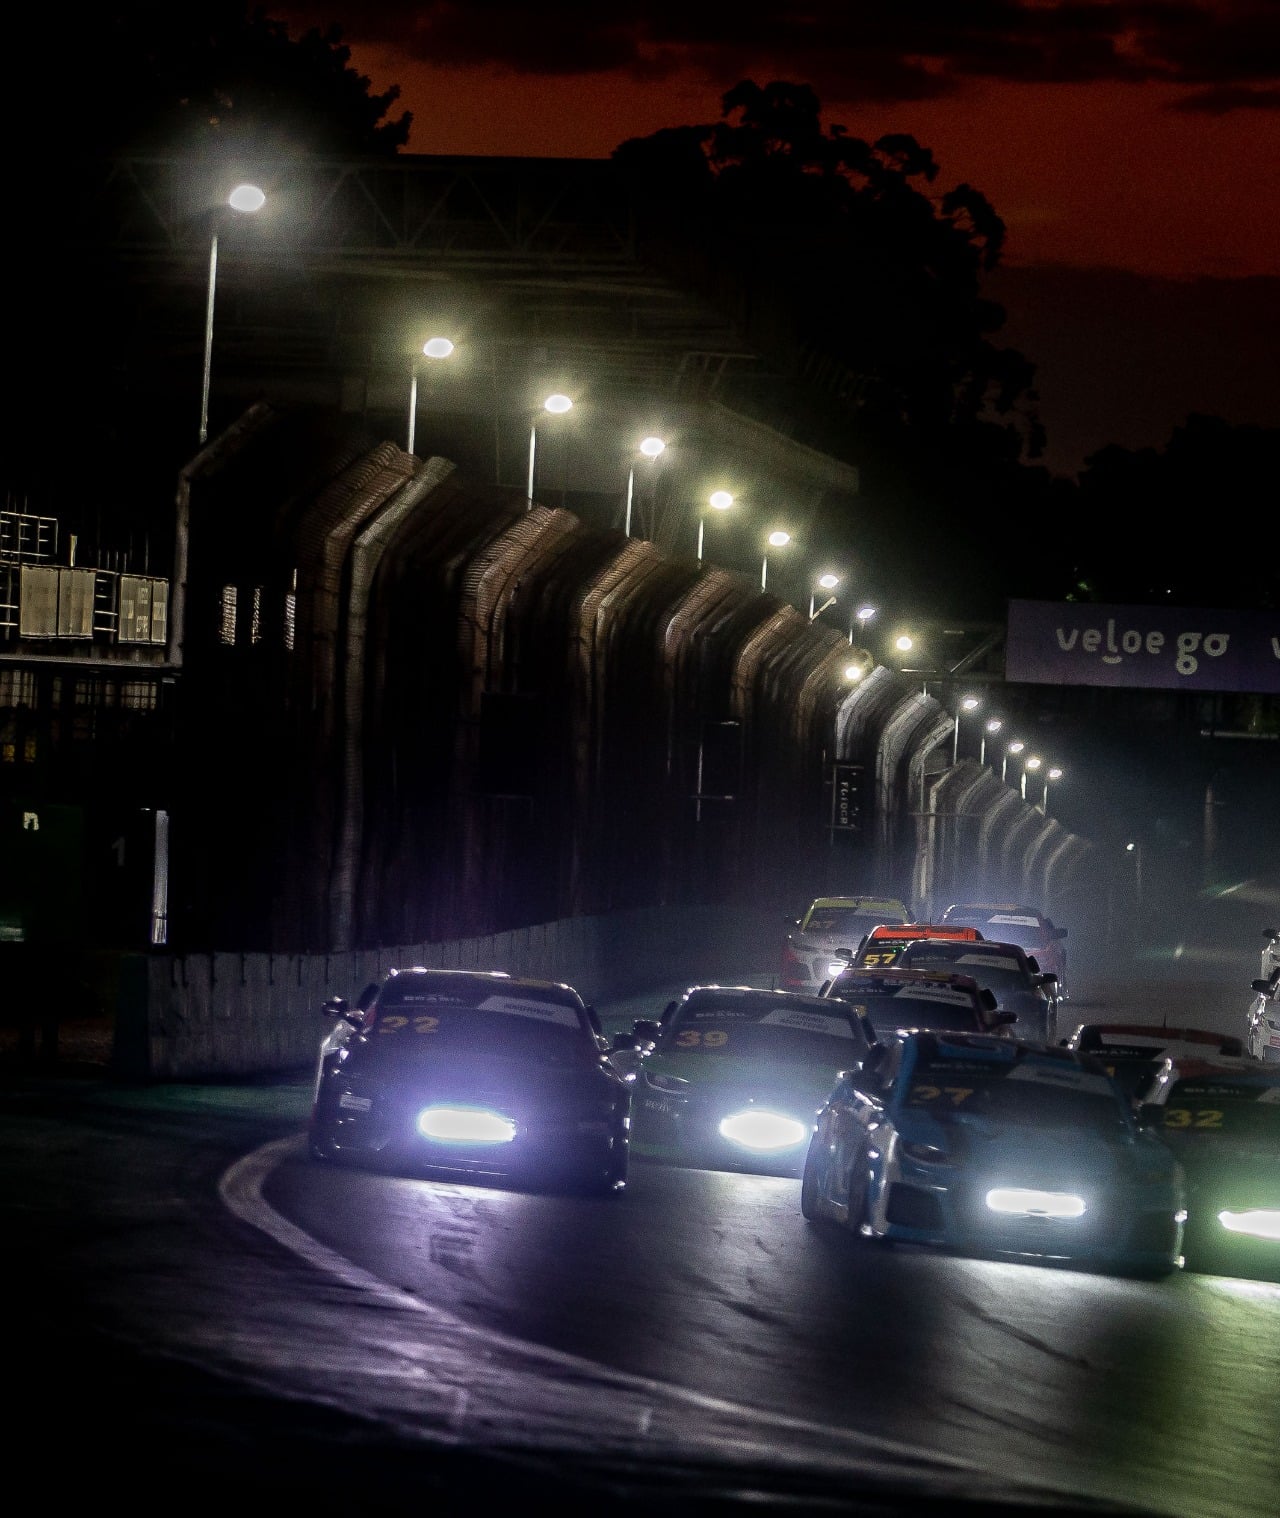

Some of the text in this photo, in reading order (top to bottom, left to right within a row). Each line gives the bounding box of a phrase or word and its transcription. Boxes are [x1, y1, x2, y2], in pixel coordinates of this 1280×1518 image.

[1056, 619, 1230, 675] veloe go
[863, 953, 896, 966] 57
[378, 1016, 440, 1034] 22
[676, 1030, 729, 1048] 39
[1165, 1109, 1224, 1128] 32
